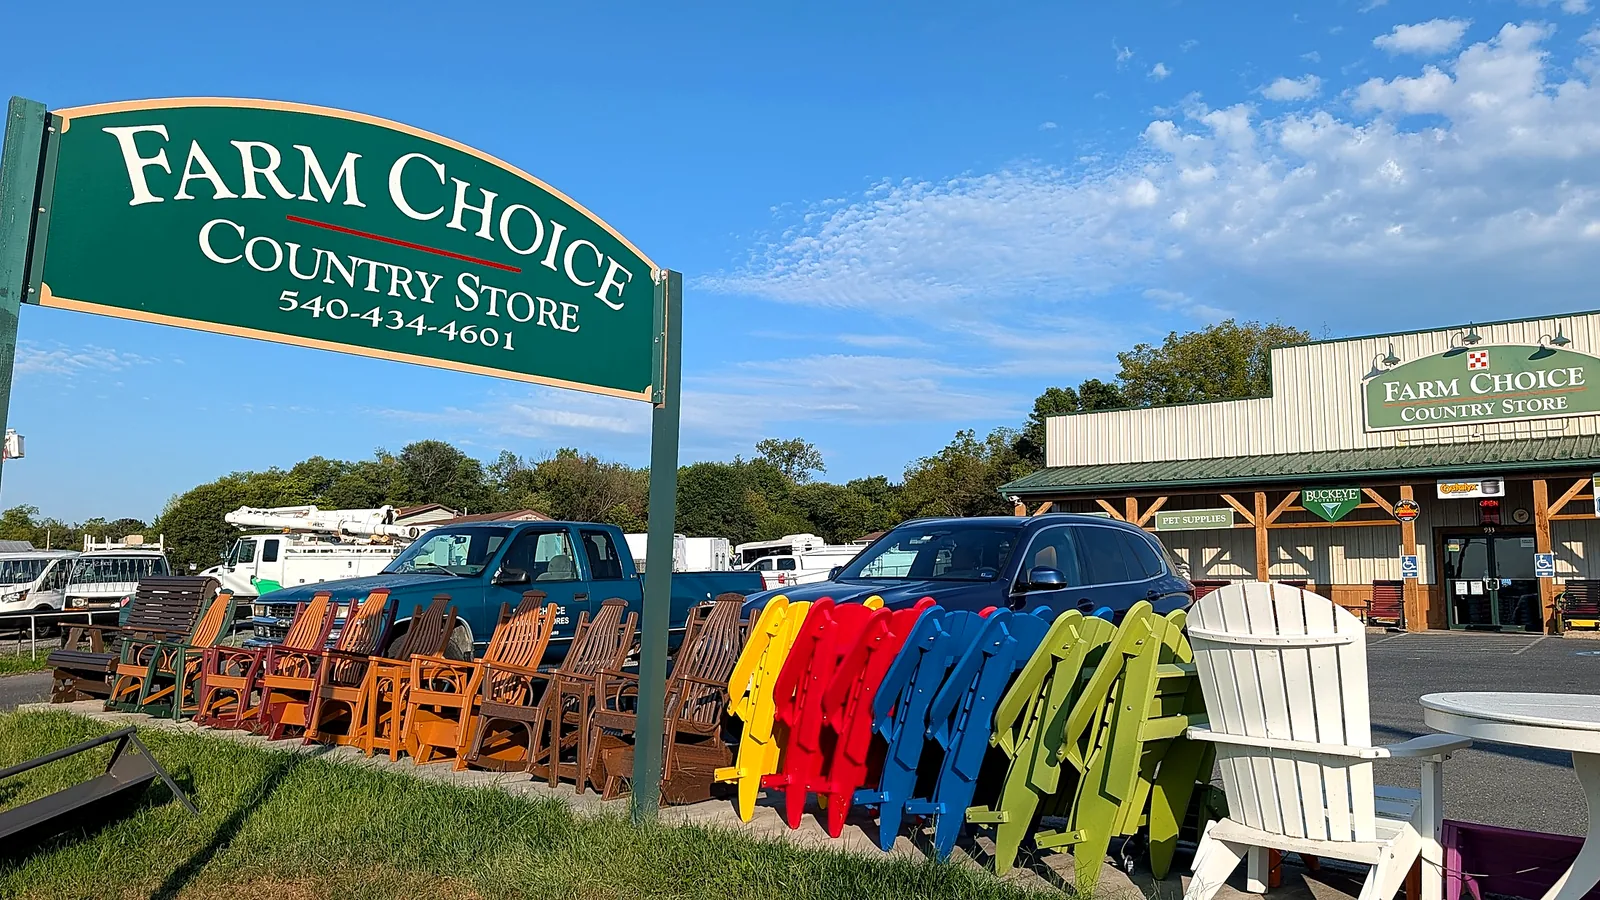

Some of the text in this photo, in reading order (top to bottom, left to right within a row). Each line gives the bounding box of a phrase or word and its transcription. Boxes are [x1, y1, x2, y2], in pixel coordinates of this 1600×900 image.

[102, 124, 633, 311] FARM CHOICE
[198, 218, 580, 333] COUNTRY STORE
[279, 290, 515, 351] 540-434-4601
[1383, 366, 1586, 402] FARM CHOICE
[1400, 396, 1569, 422] COUNTRY STORE
[1305, 488, 1358, 502] BUCKEYE
[1162, 514, 1227, 525] PET SUPPLIES
